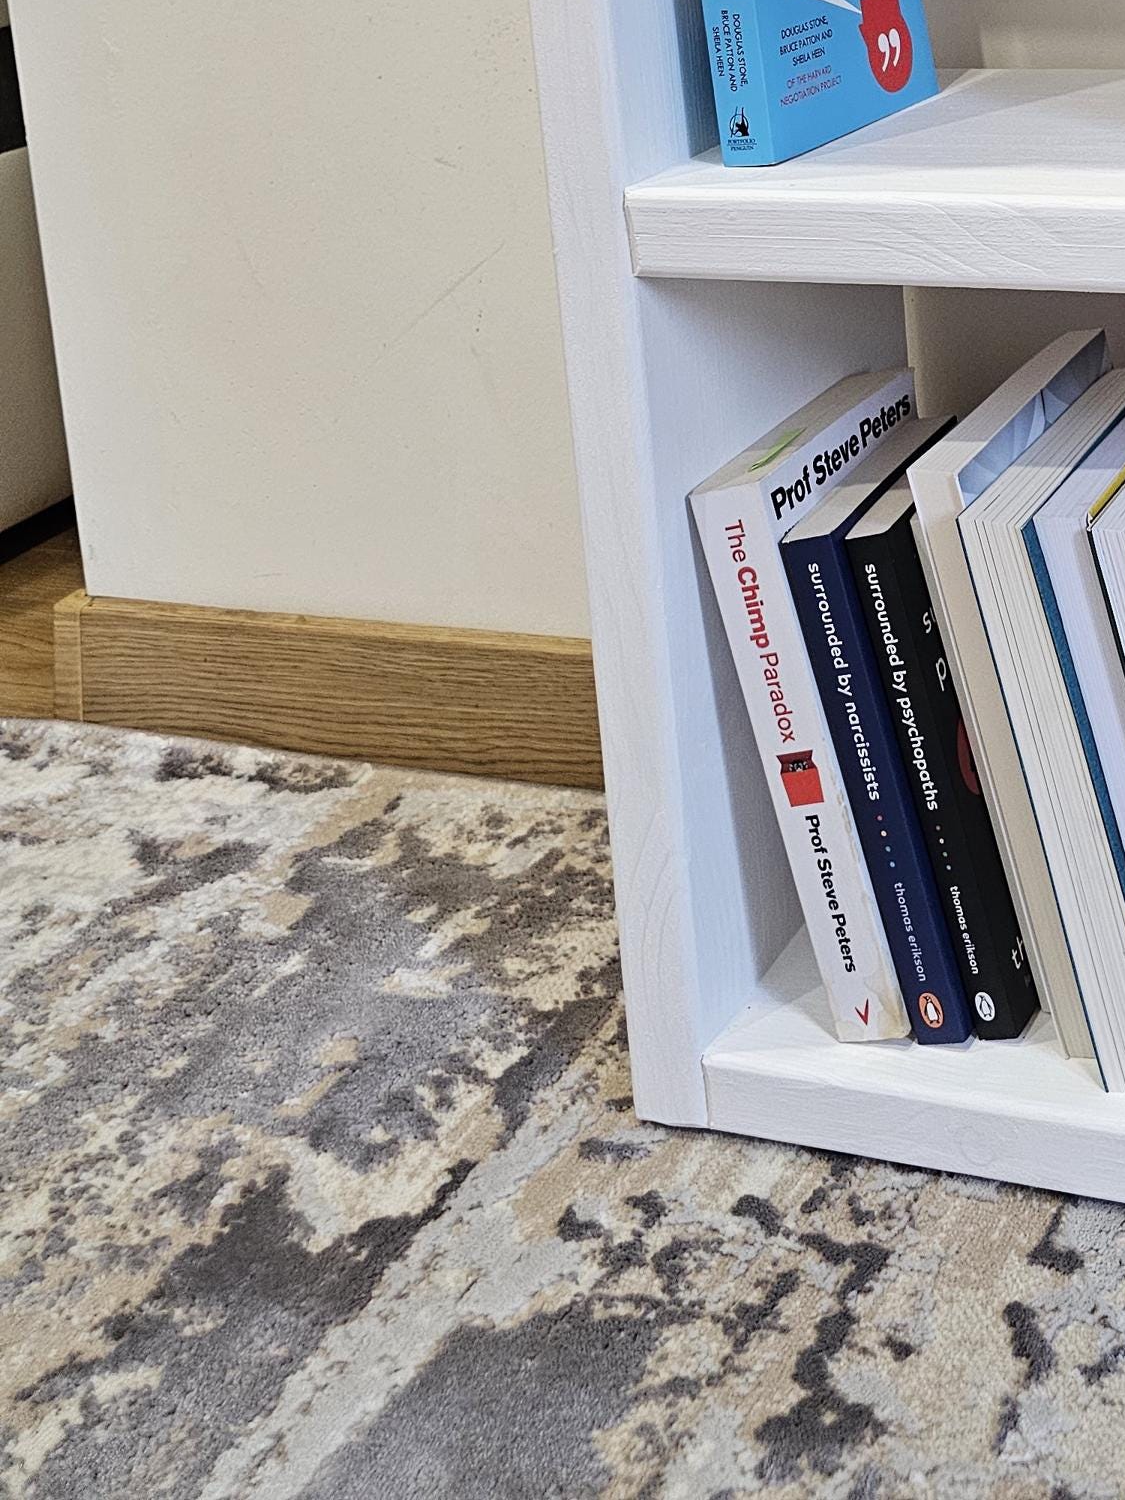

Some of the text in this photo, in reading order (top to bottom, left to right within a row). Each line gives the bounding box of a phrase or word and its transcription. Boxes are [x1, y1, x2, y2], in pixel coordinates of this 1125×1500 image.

[712, 26, 725, 77] SHEILA HEEN
[720, 9, 738, 92] BRUCE PATTON AND
[732, 13, 749, 87] DOUGLAS STONE,
[780, 28, 833, 56] BRUCE PATTON AND
[781, 22, 809, 39] DOUGLAS
[792, 46, 826, 67] SHEILA HEEN
[786, 65, 833, 89] OF THE HARVARD
[770, 394, 911, 521] Prof Steve Peters
[725, 519, 796, 744] The Chimp Paradox
[808, 562, 880, 801] surrounded by narcissists
[865, 563, 938, 811] surrounded by psychopaths
[805, 814, 856, 974] Prof Steve Peters
[894, 882, 927, 982] thomas erikson
[949, 885, 979, 975] thomas erikson
